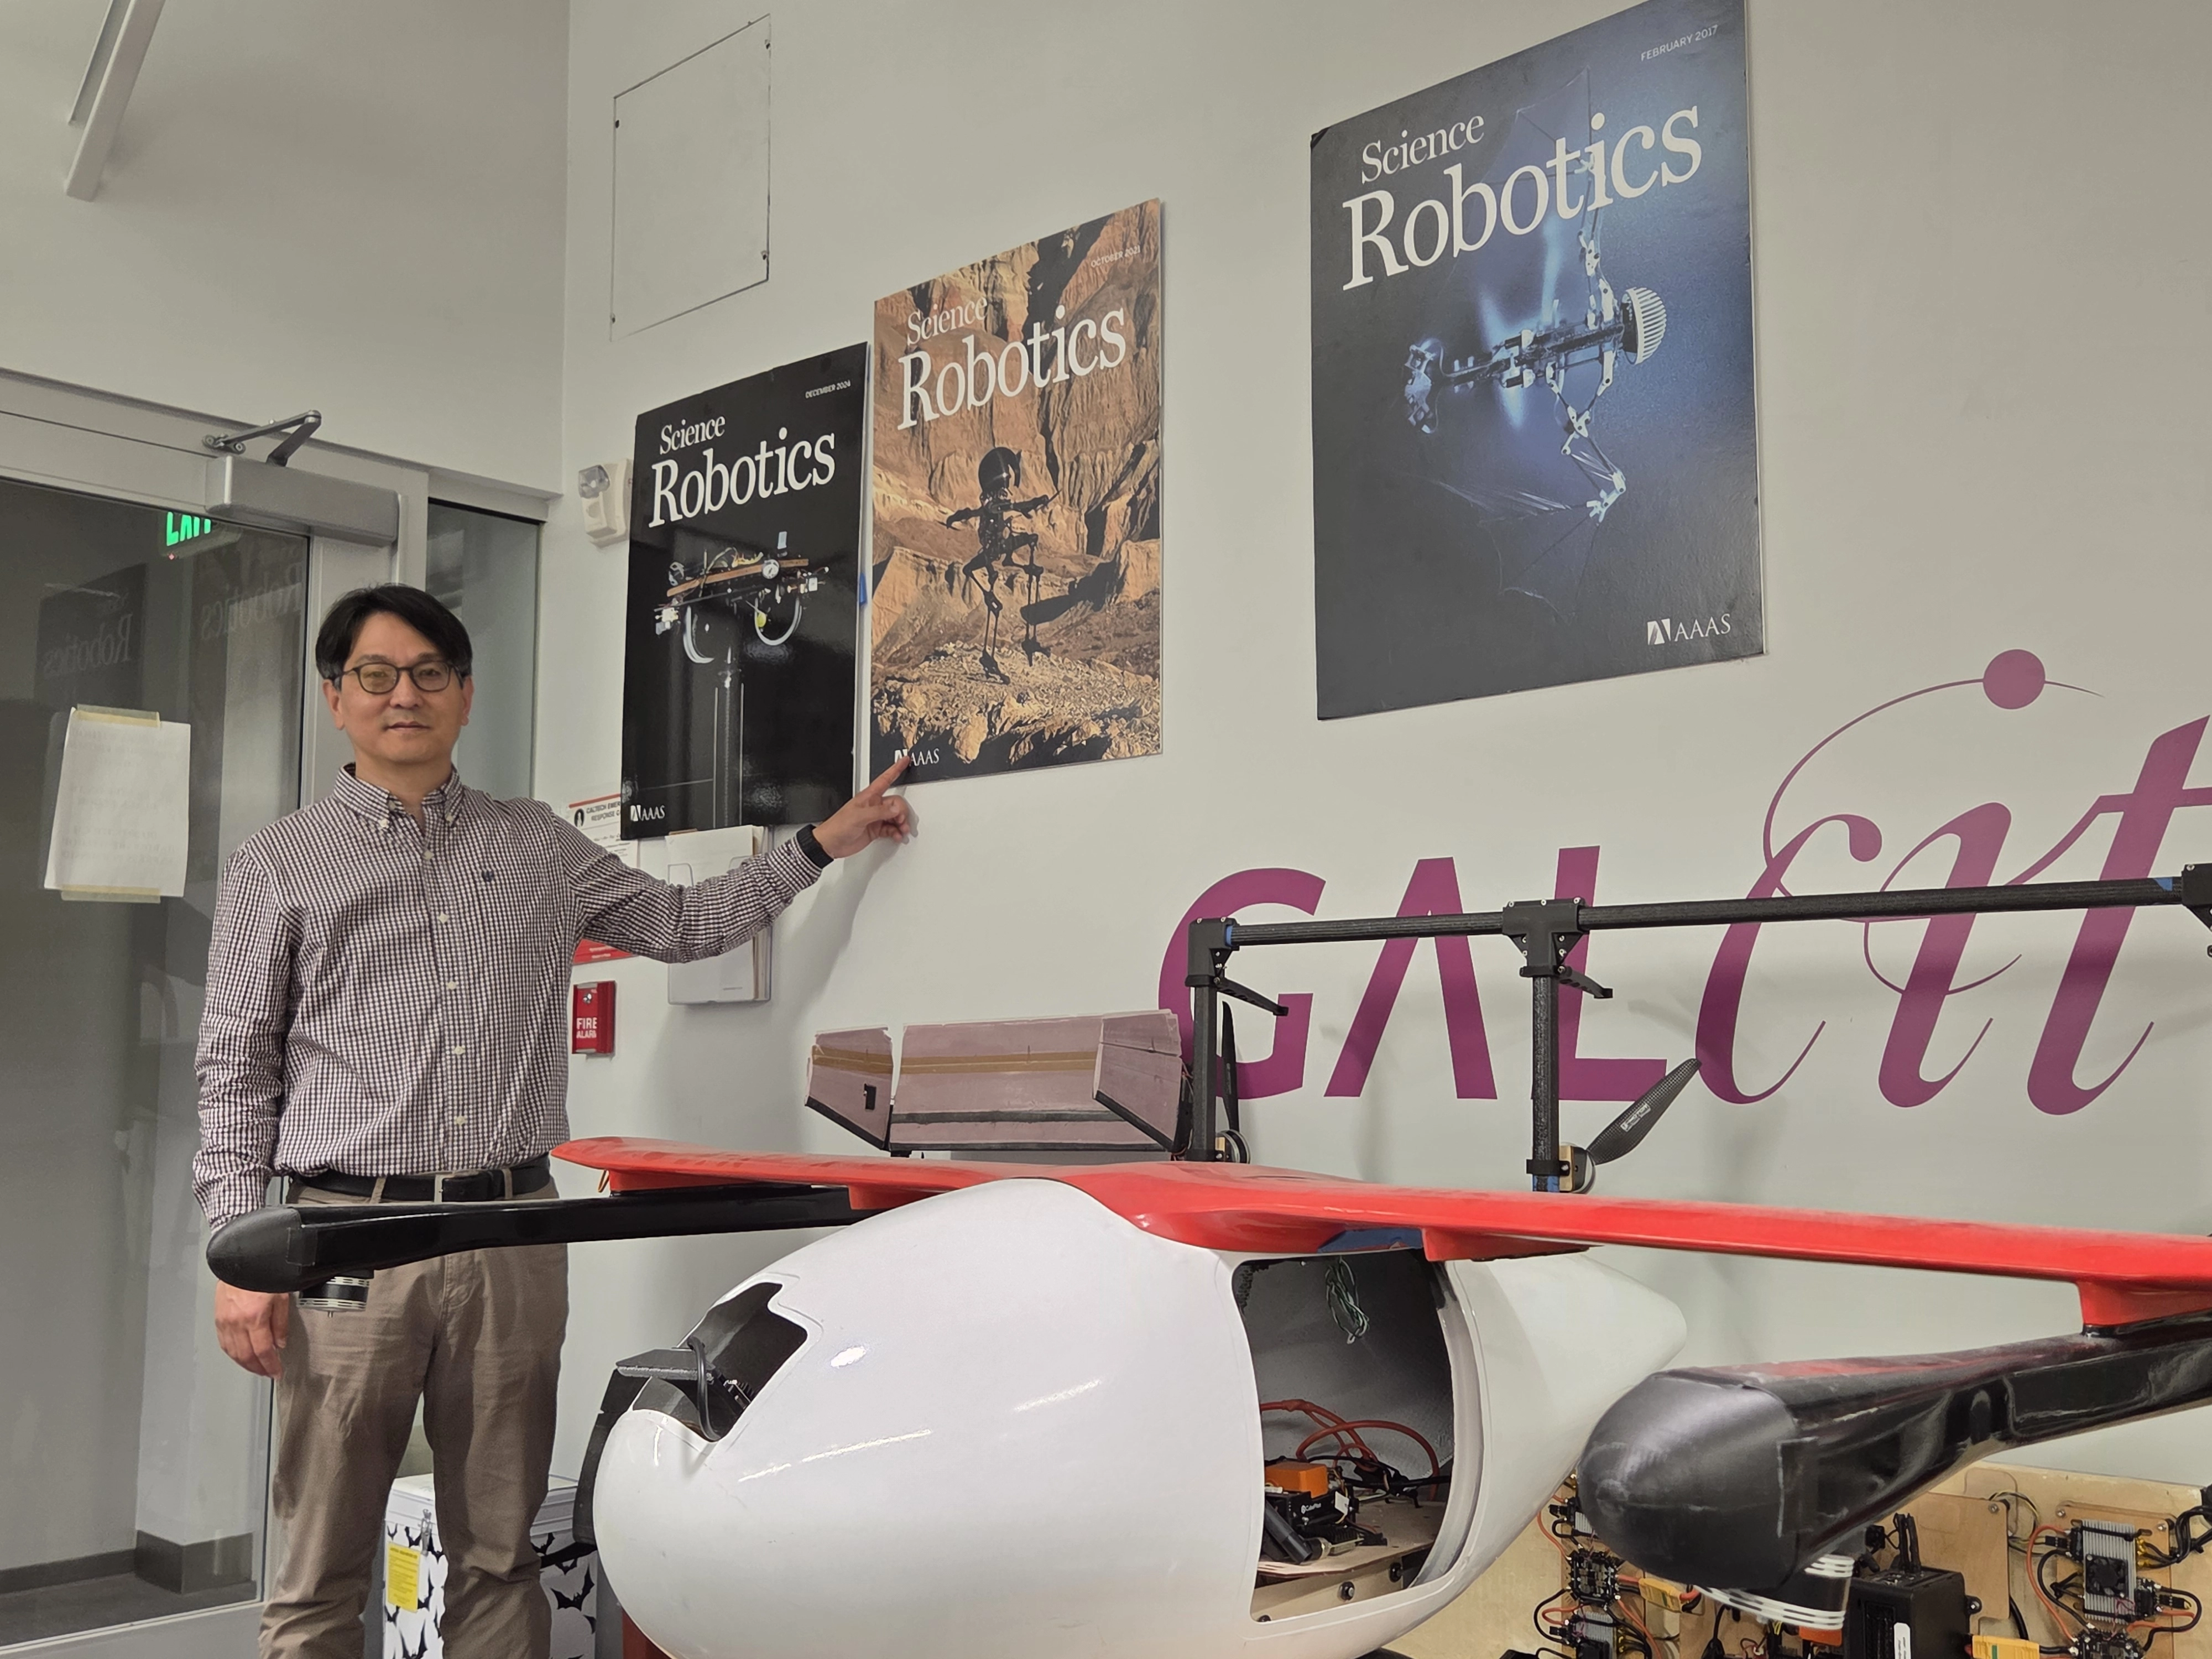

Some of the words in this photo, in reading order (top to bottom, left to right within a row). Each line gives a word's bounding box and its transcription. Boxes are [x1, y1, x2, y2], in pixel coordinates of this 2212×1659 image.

[1641, 34, 1693, 62] FEBRUARY
[1695, 24, 1718, 41] 2017
[1361, 115, 1485, 185] Science
[1342, 105, 1703, 291] Robotics
[1091, 251, 1123, 268] OCTOBER
[1124, 244, 1141, 258] 2021
[907, 296, 988, 347] Science
[897, 304, 1126, 431] Robotics
[805, 384, 836, 399] DECEMBER
[659, 416, 726, 455] Science
[648, 426, 836, 529] Robotics
[1674, 613, 1731, 642] AAAS
[910, 748, 940, 767] AAAS
[642, 805, 666, 821] AAAS
[576, 1017, 597, 1030] FIRE
